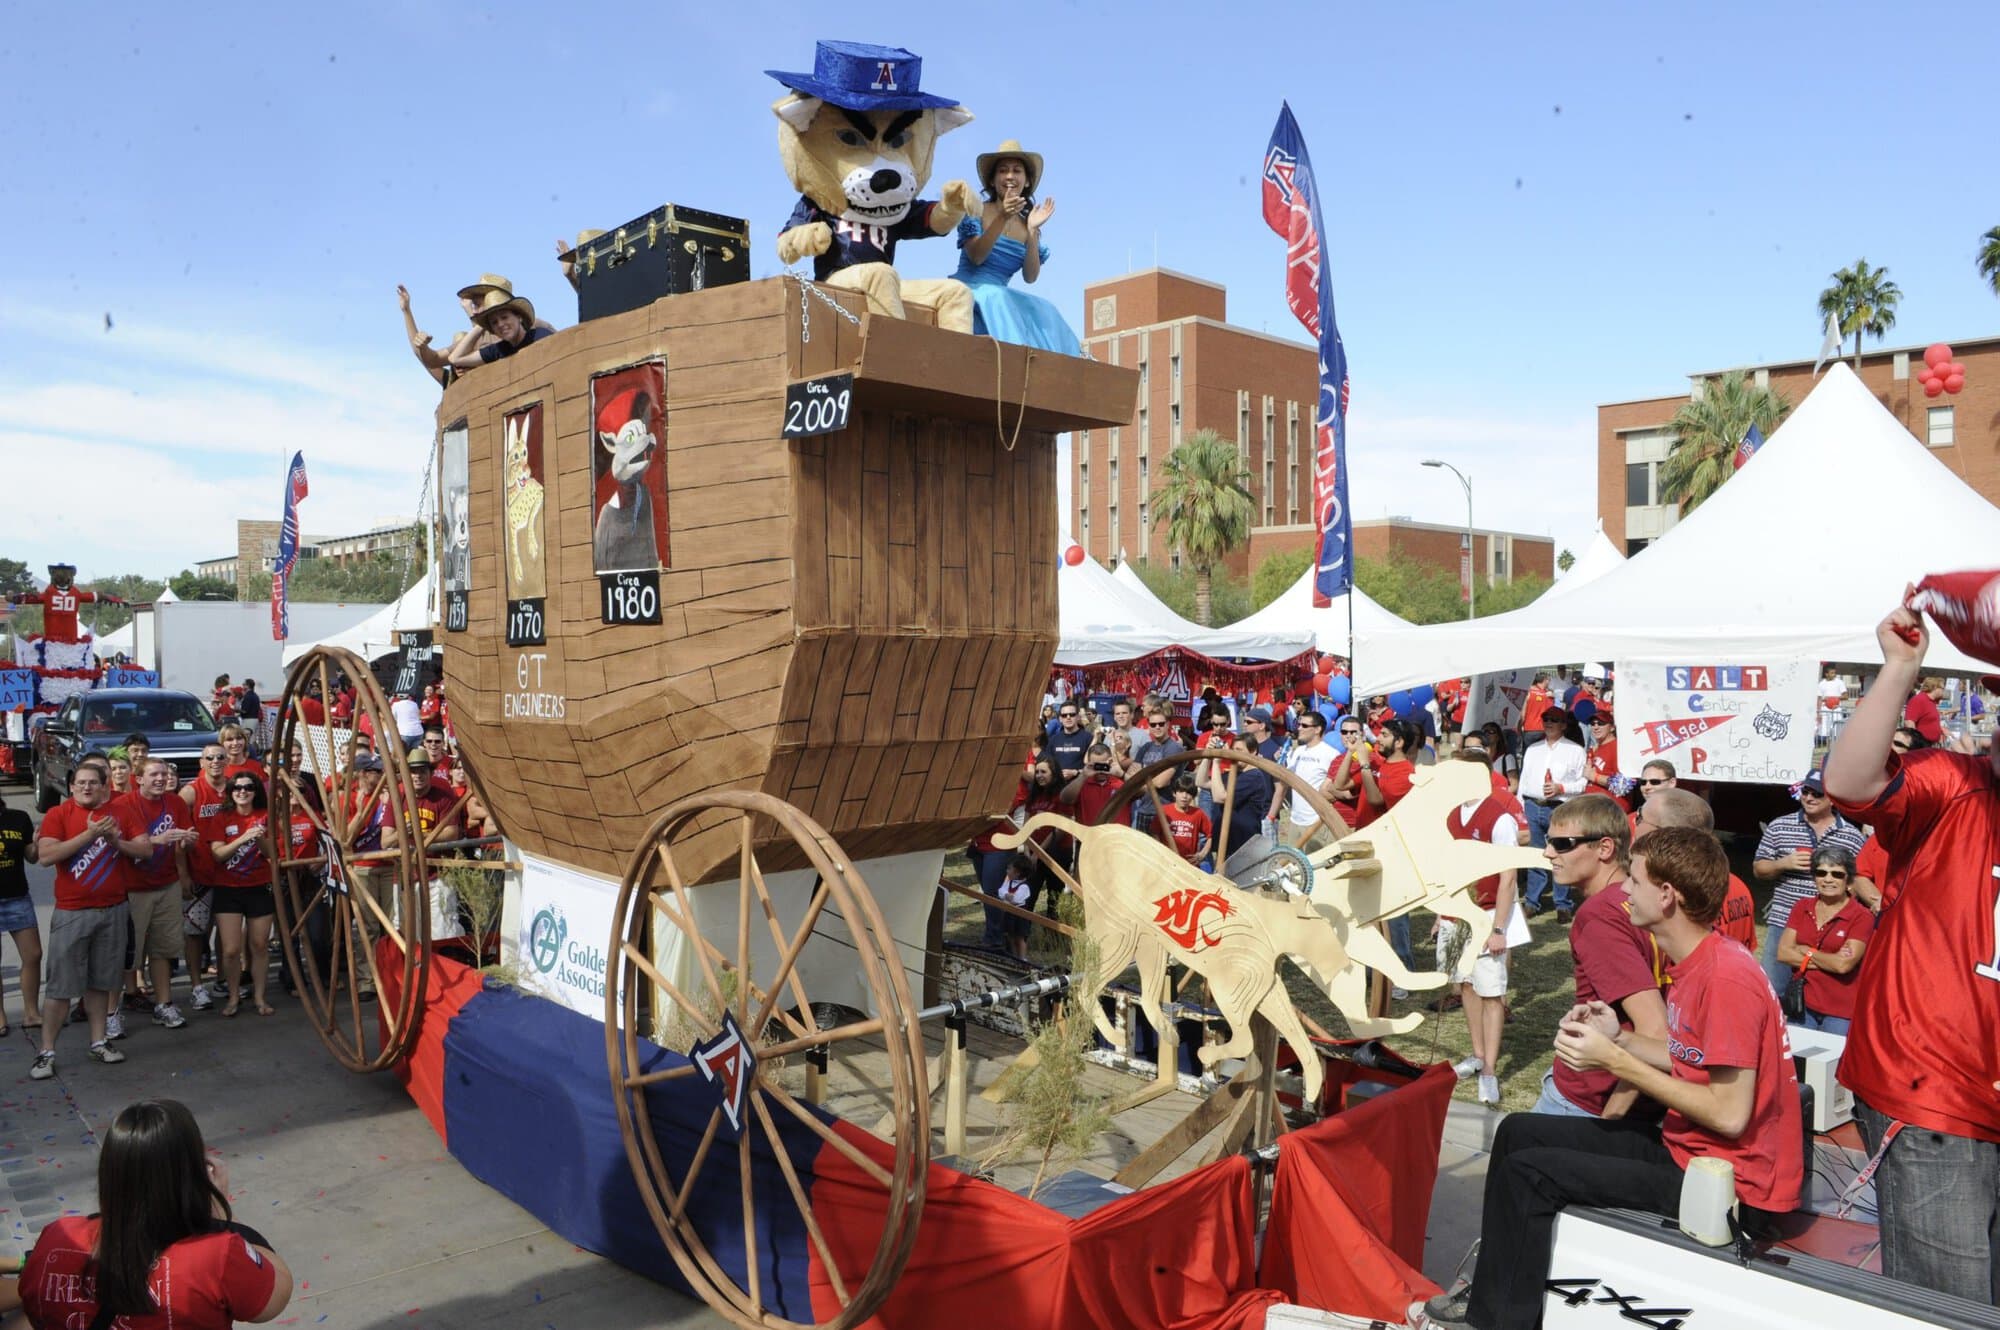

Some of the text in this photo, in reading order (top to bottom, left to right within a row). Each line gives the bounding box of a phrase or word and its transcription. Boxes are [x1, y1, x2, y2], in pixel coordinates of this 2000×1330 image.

[870, 62, 897, 91] A
[807, 381, 829, 394] Circa
[784, 389, 850, 432] 2009
[617, 573, 641, 587] Circa
[52, 595, 76, 611] 50
[448, 602, 466, 629] 1959
[607, 585, 656, 621] 1980
[510, 611, 542, 640] 1970
[1671, 668, 1763, 689] SALT
[504, 693, 566, 718] ENGINEERS
[1688, 693, 1748, 713] Center
[1656, 718, 1709, 750] Aged
[1728, 725, 1750, 749] to
[556, 960, 625, 1006] Associas
